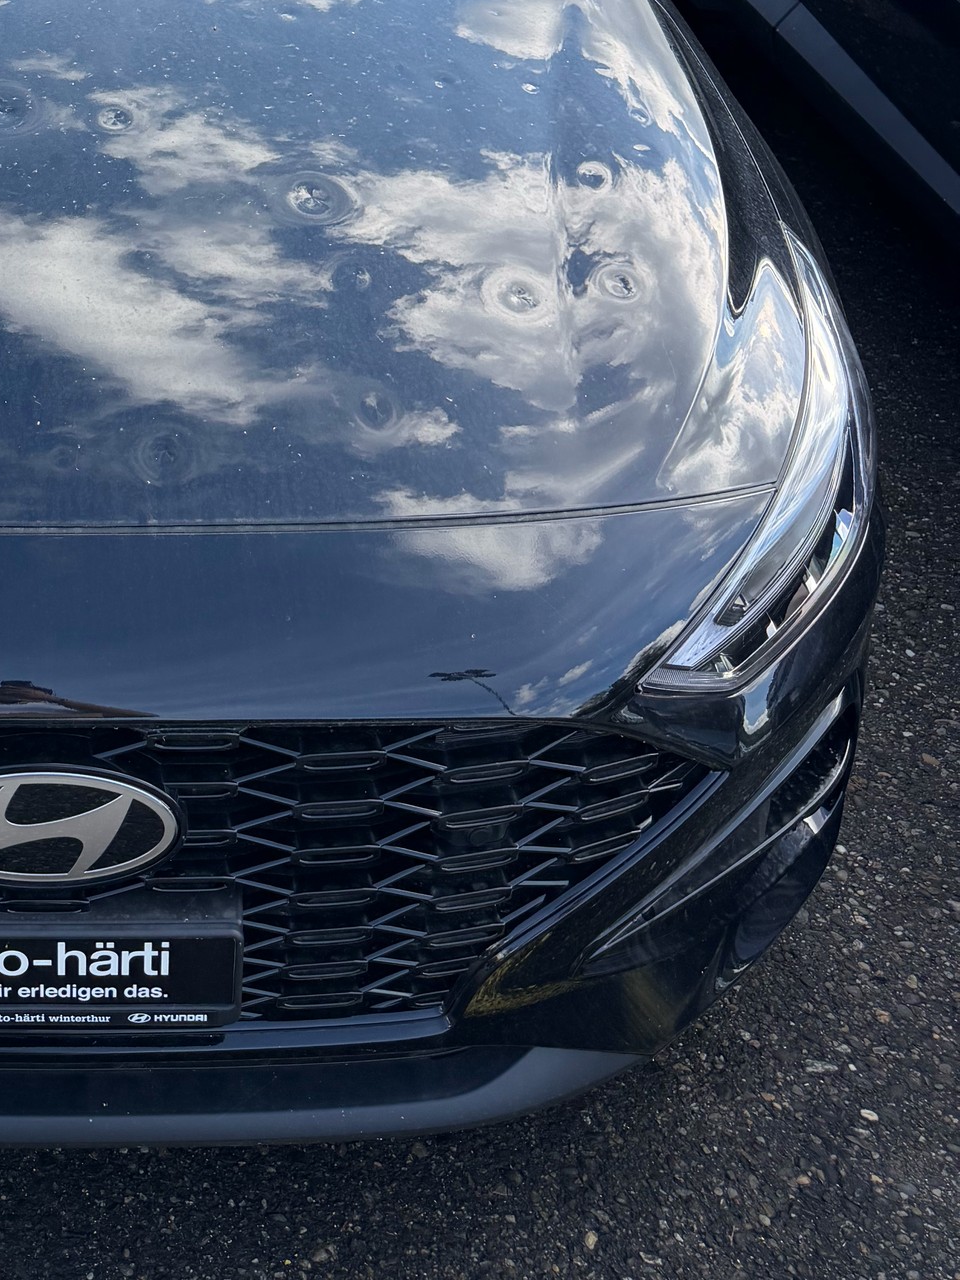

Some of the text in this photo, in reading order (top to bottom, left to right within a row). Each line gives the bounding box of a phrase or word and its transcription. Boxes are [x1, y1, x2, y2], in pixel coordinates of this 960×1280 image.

[17, 983, 118, 1002] erledigen
[123, 983, 169, 998] das.
[48, 1014, 112, 1023] winterthur
[153, 1014, 208, 1022] HYUNDAI
